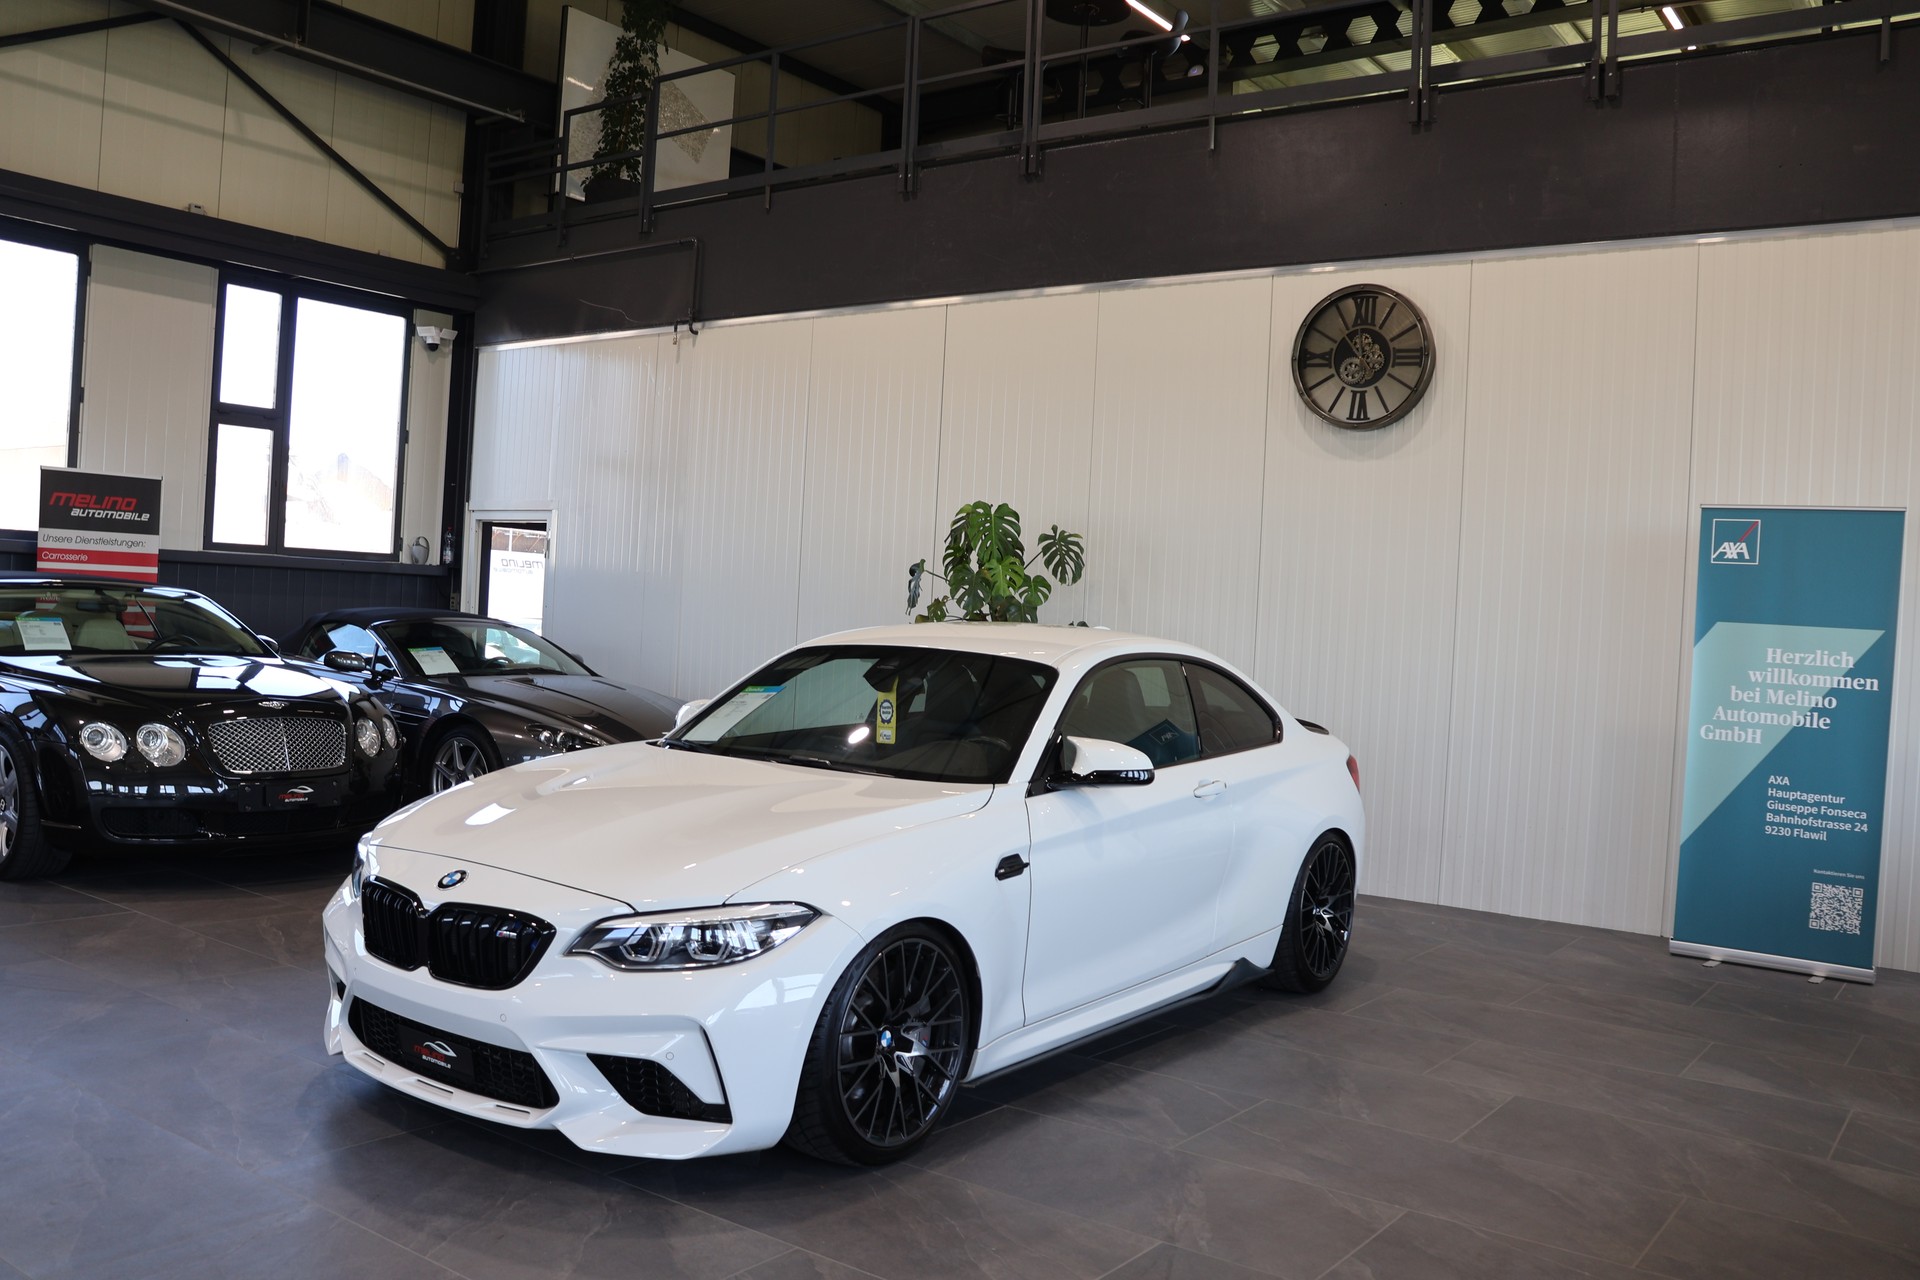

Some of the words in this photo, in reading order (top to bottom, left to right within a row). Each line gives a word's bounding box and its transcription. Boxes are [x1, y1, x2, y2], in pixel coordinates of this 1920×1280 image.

[42, 533, 74, 545] Unsere
[74, 535, 147, 549] Dienstleistungen:
[1712, 541, 1750, 560] AXA
[41, 551, 89, 563] Carrosserie
[1765, 648, 1855, 669] Herzlich
[1748, 668, 1880, 692] willkommen
[1730, 685, 1761, 704] bei
[1765, 688, 1838, 710] Melino
[1712, 705, 1832, 730] Automobile
[1699, 724, 1763, 745] GmbH
[1768, 775, 1790, 786] AXA
[1767, 787, 1846, 805] Hauptagentur
[1766, 800, 1818, 815] Giuseppe
[1820, 805, 1867, 819] Fonseca
[1766, 812, 1852, 831] Bahnhofstrasse
[1853, 822, 1868, 833] 24
[1764, 825, 1792, 837] 9230
[1793, 828, 1827, 841] Flawil
